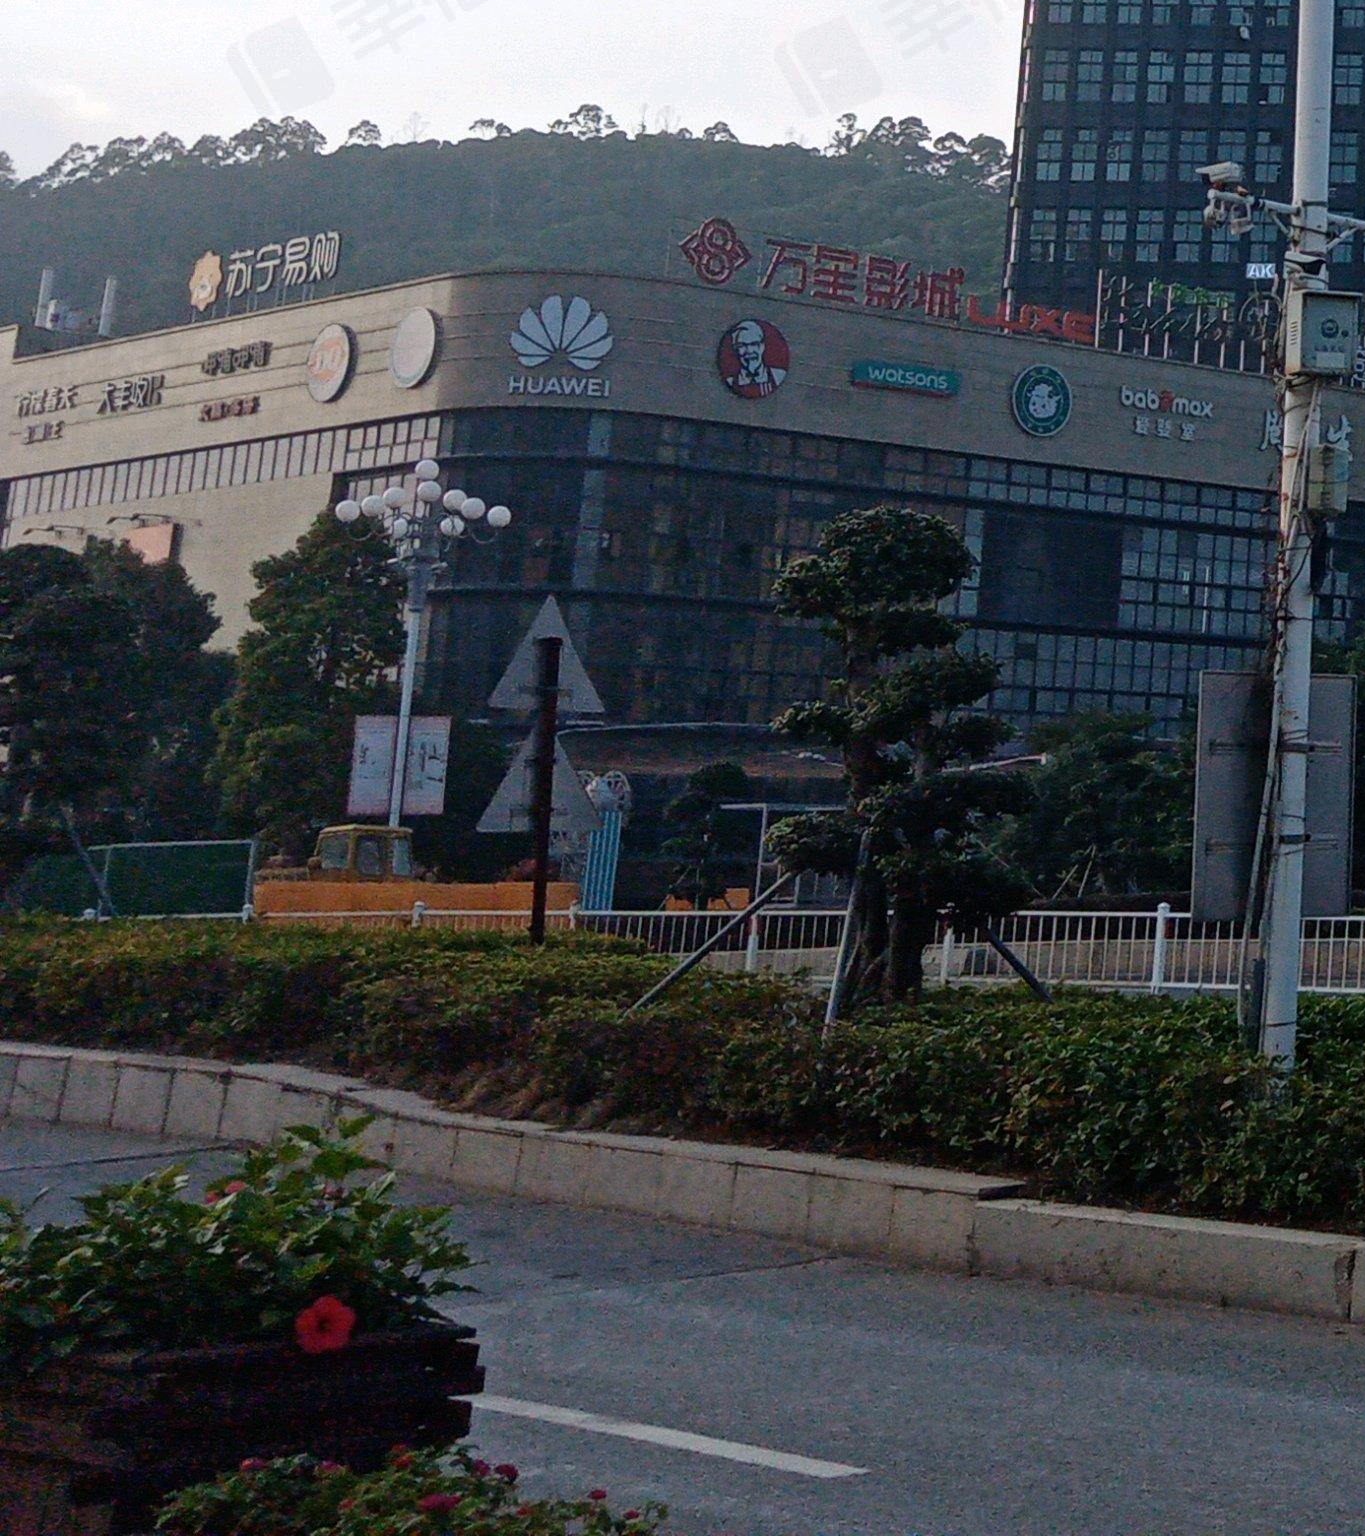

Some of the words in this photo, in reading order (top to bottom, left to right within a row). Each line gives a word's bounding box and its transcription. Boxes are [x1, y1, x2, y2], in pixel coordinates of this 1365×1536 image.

[225, 230, 341, 298] 苏宁易购
[508, 375, 611, 397] HUAWEI
[868, 364, 948, 390] watsons
